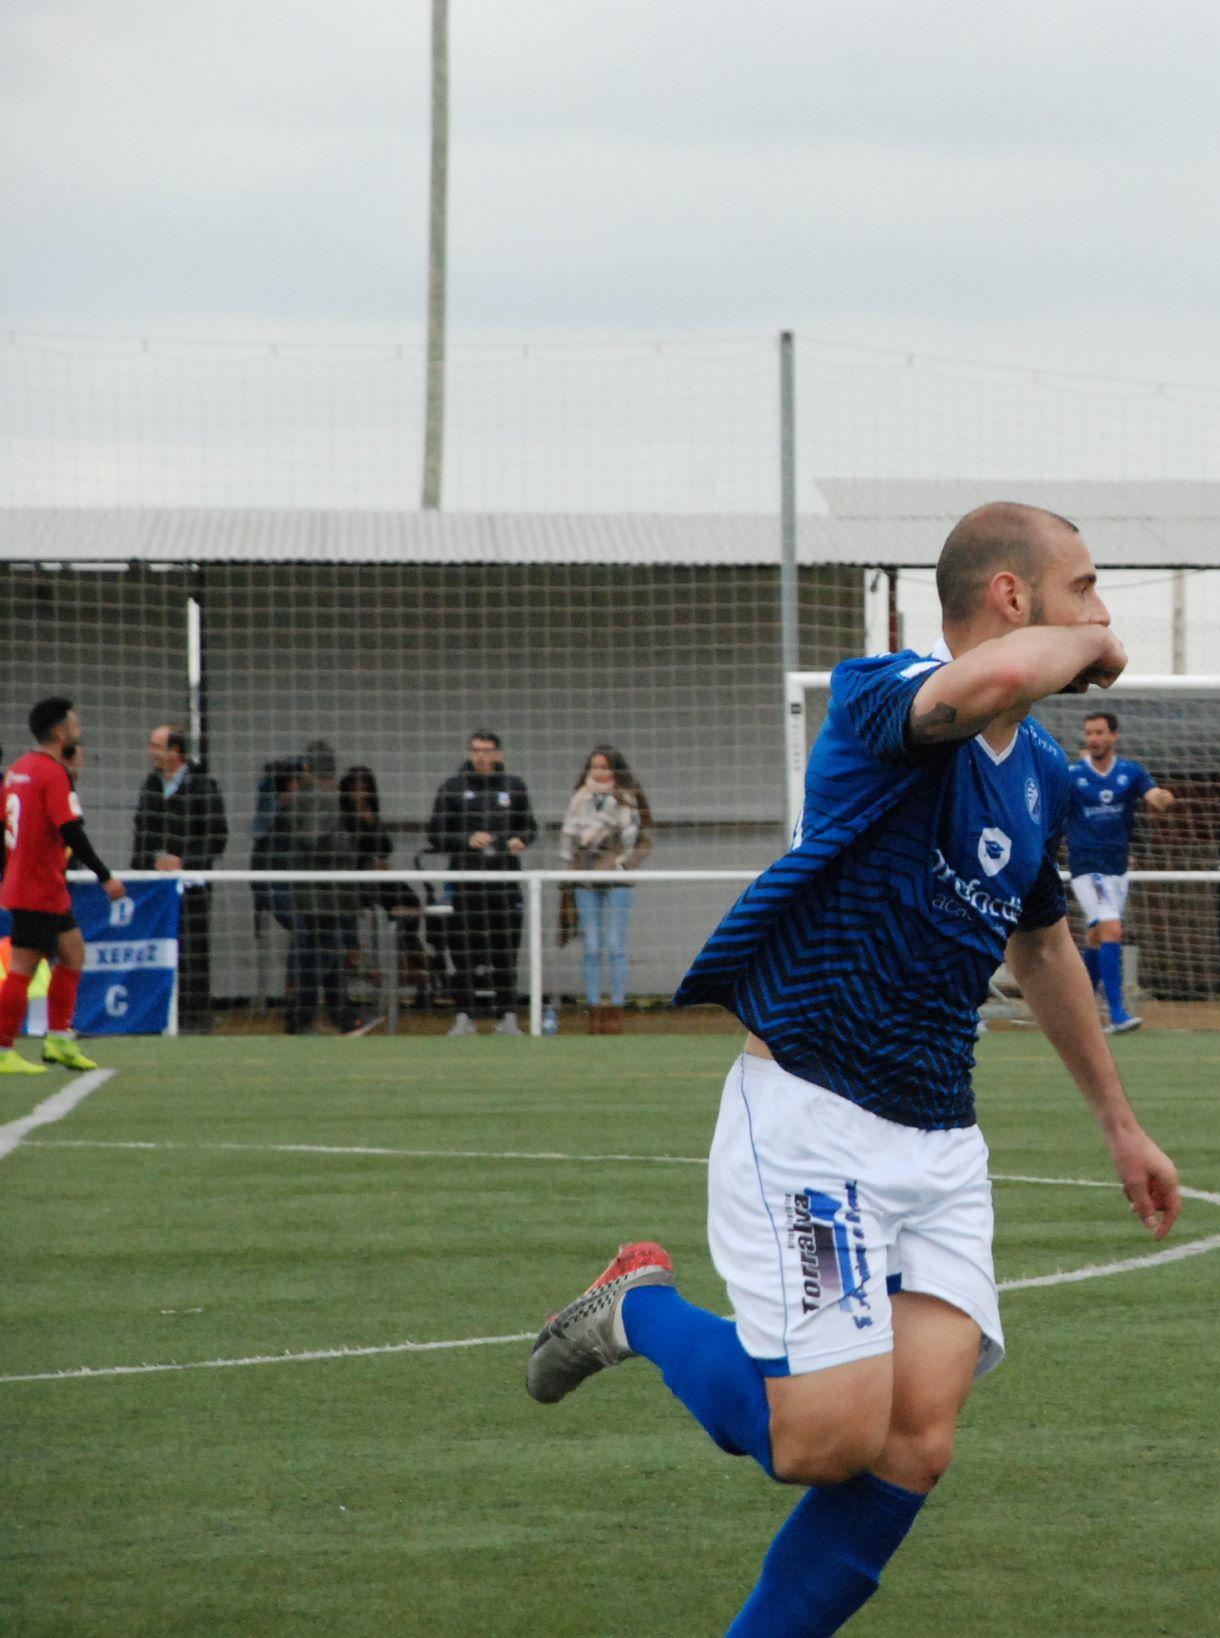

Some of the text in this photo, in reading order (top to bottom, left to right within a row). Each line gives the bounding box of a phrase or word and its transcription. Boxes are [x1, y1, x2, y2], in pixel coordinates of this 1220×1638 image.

[109, 897, 135, 928] D
[105, 984, 129, 1018] C
[794, 1193, 821, 1315] Torralva
